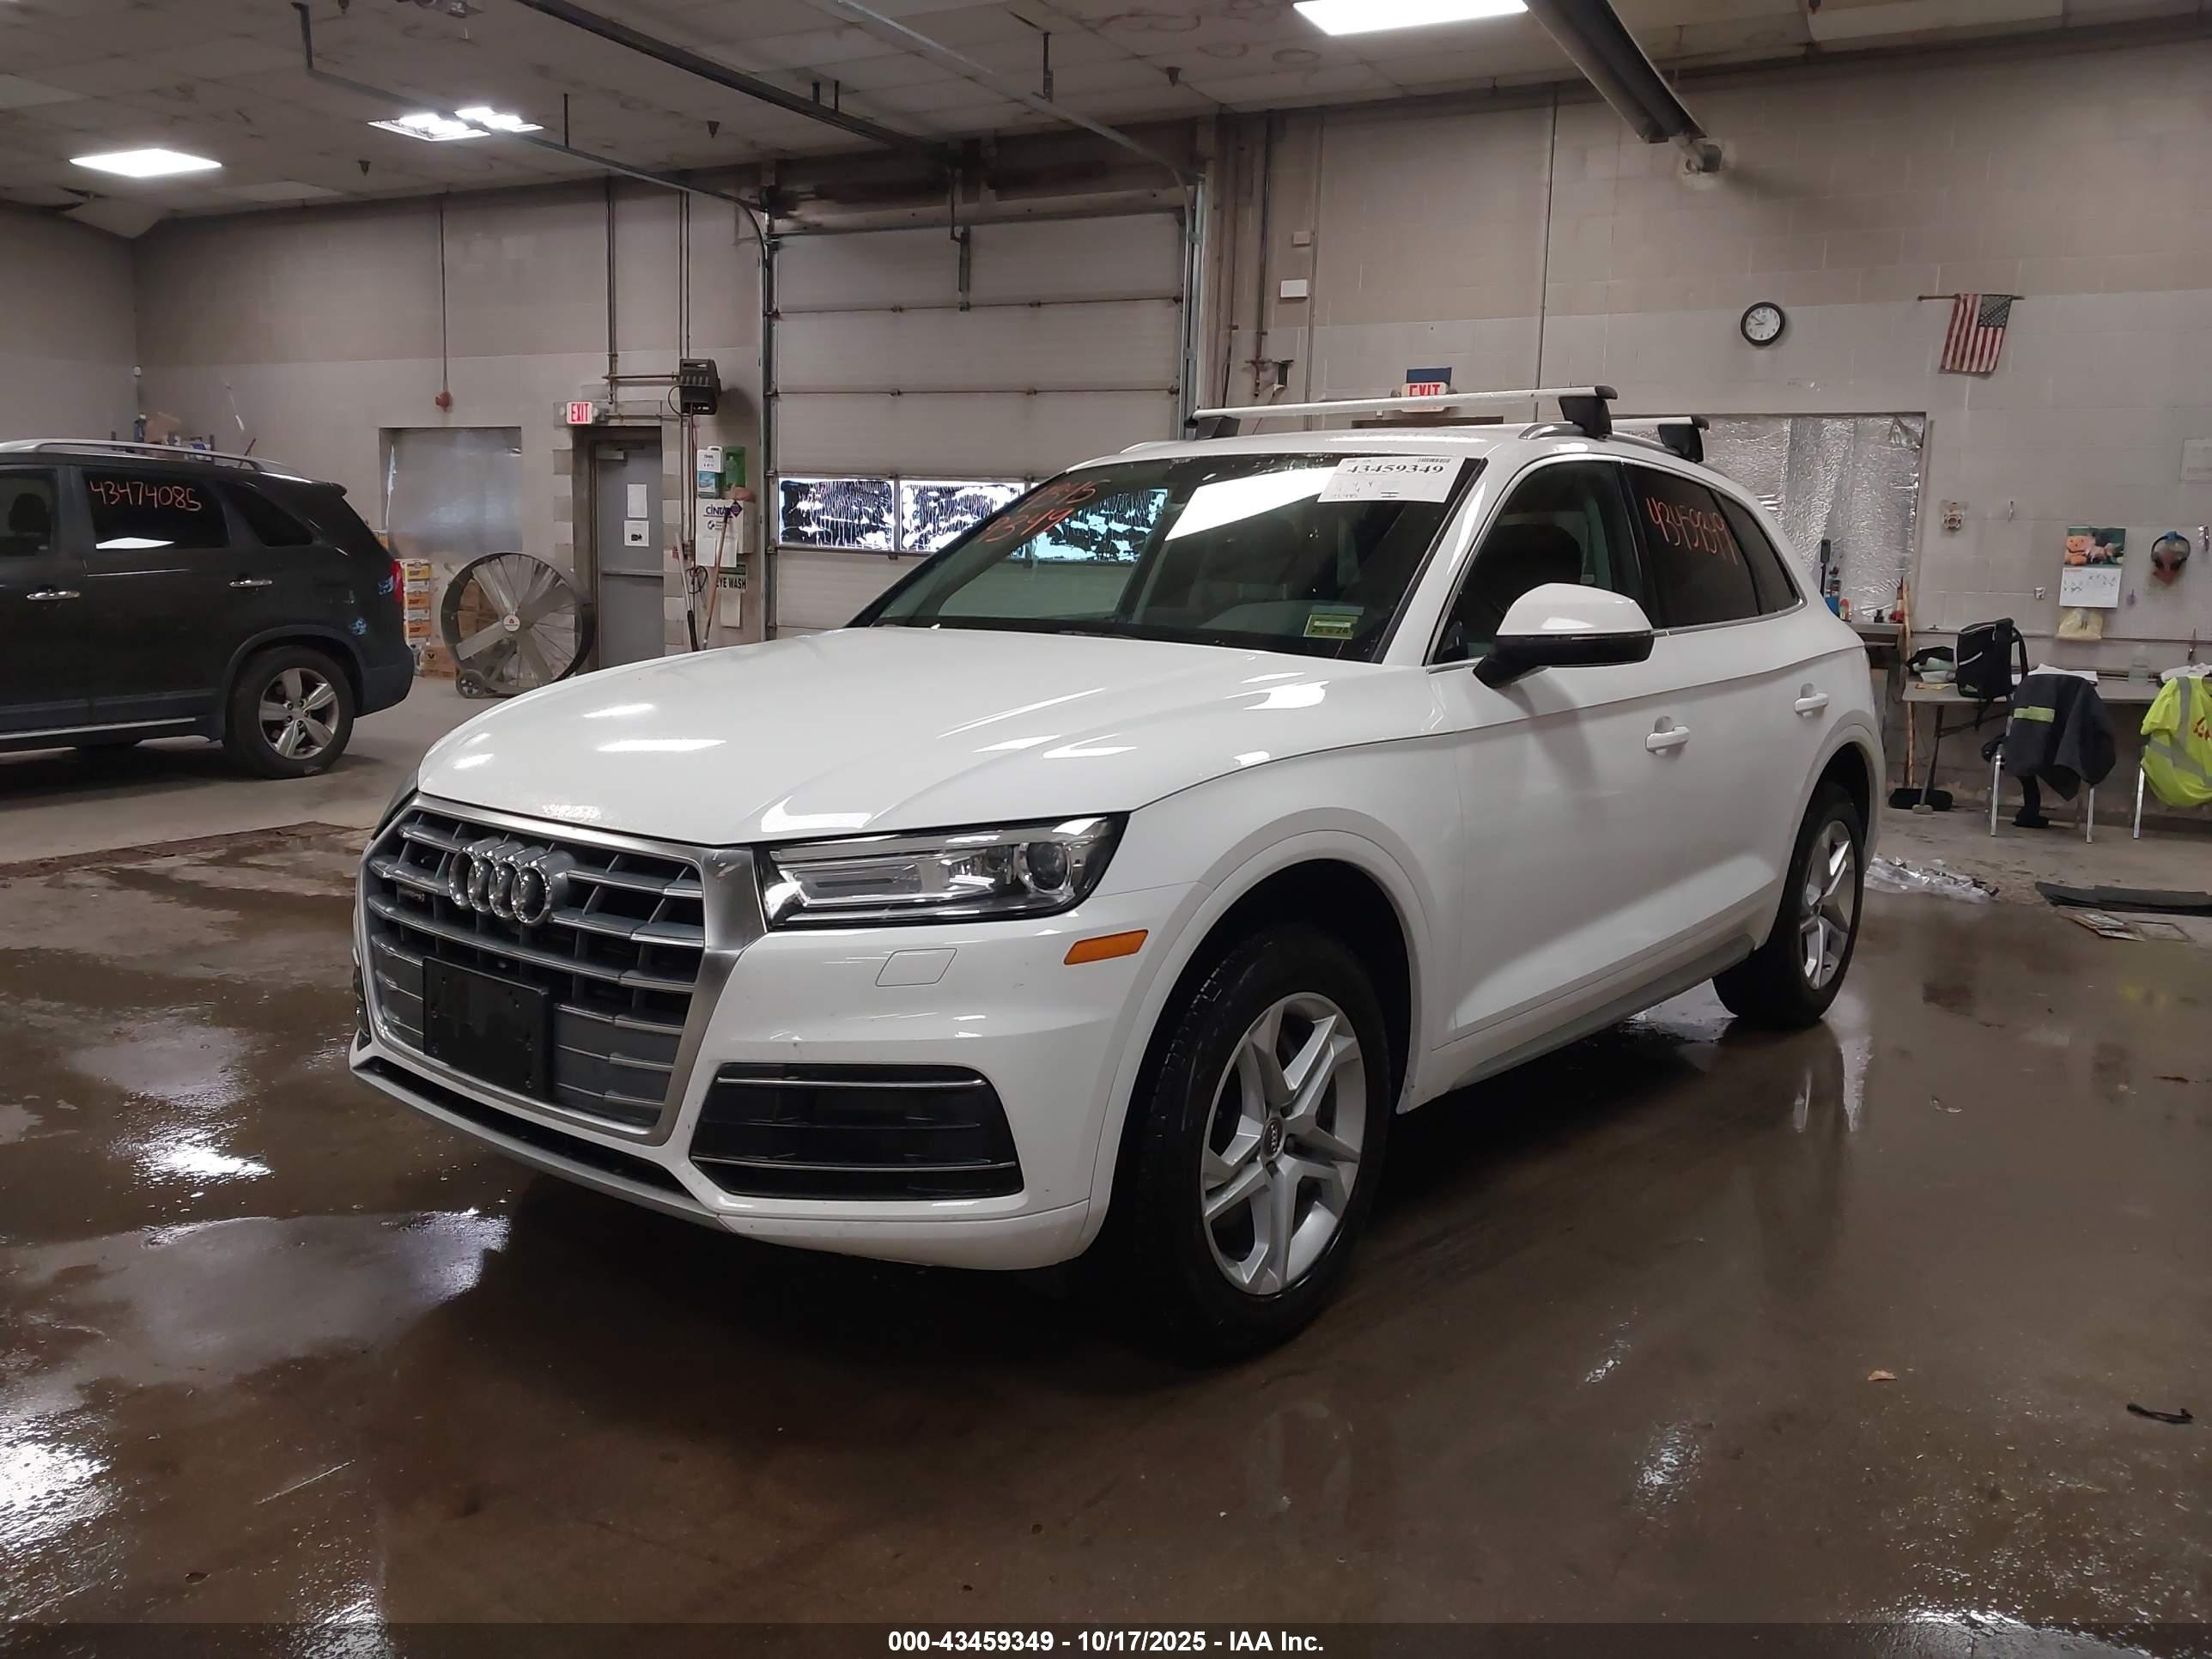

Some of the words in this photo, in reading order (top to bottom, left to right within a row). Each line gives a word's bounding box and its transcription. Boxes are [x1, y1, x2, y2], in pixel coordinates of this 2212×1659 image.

[571, 403, 589, 422] EXIT
[1346, 464, 1444, 474] 43459349
[89, 480, 202, 512] 43474085
[1646, 496, 1738, 566] 43459349
[728, 576, 746, 589] WASH
